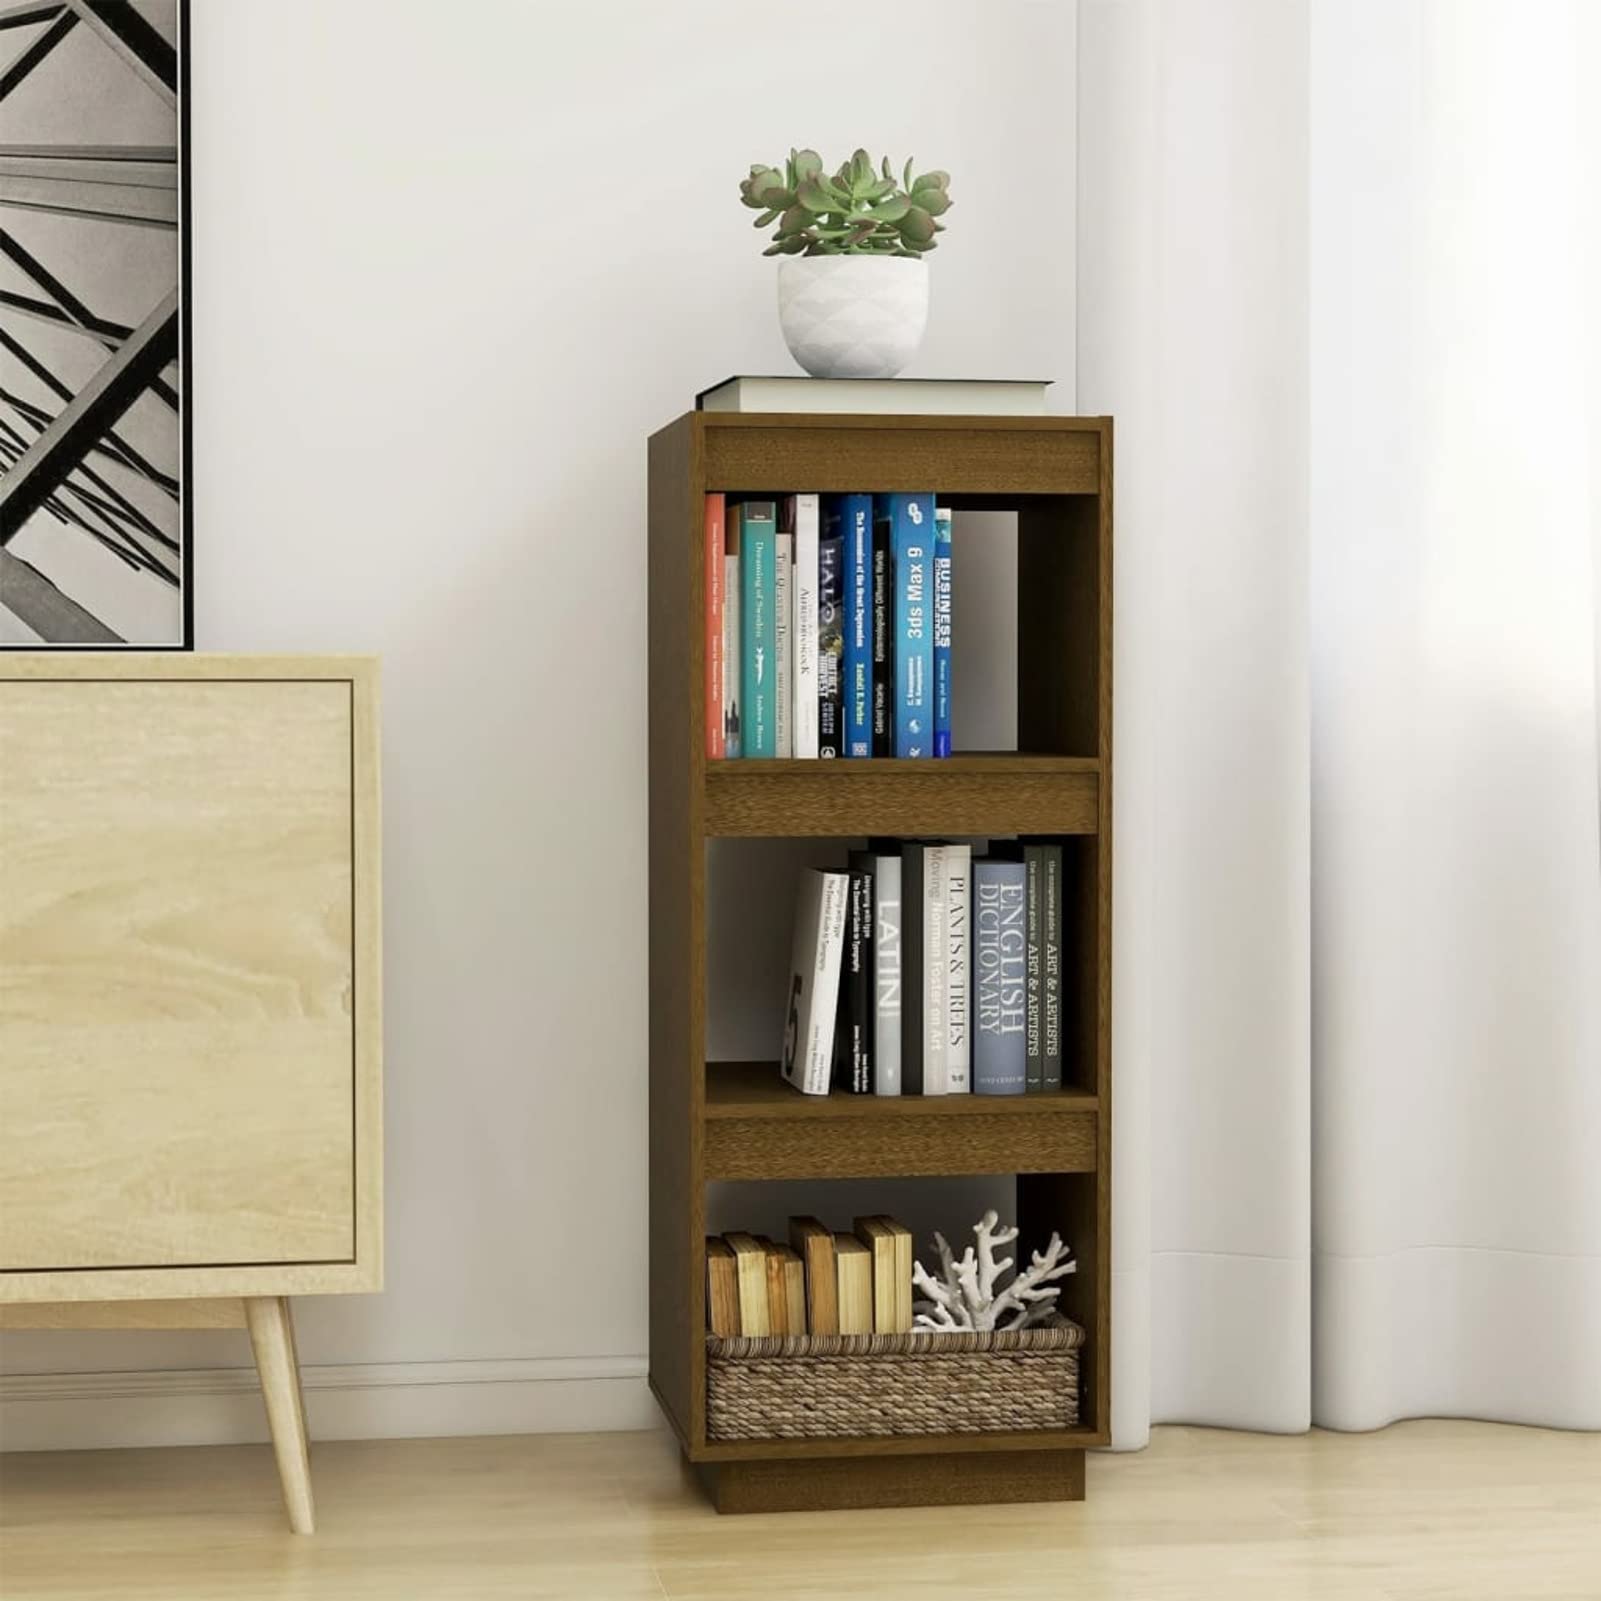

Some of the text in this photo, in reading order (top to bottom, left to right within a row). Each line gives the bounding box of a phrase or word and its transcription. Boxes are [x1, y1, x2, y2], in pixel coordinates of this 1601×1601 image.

[907, 546, 923, 558] 9
[820, 549, 835, 625] HALO
[907, 562, 923, 601] Max
[940, 557, 952, 648] BUSINESS
[907, 606, 923, 639] 3ds
[928, 849, 944, 898] Moving
[930, 902, 945, 957] Norman
[878, 901, 900, 1007] LATIN
[949, 877, 965, 1046] PLANTS & TREES
[978, 883, 1000, 1036] DICTIONARY
[999, 883, 1025, 1035] ENGLISH
[1028, 943, 1039, 975] ART
[1047, 943, 1058, 975] ART
[930, 960, 945, 1004] Foster
[1028, 977, 1039, 991] &
[1047, 977, 1058, 991] &
[930, 1007, 945, 1025] on
[1028, 993, 1039, 1057] ARTISTS
[1047, 993, 1058, 1057] ARTISTS
[930, 1029, 945, 1051] Art
